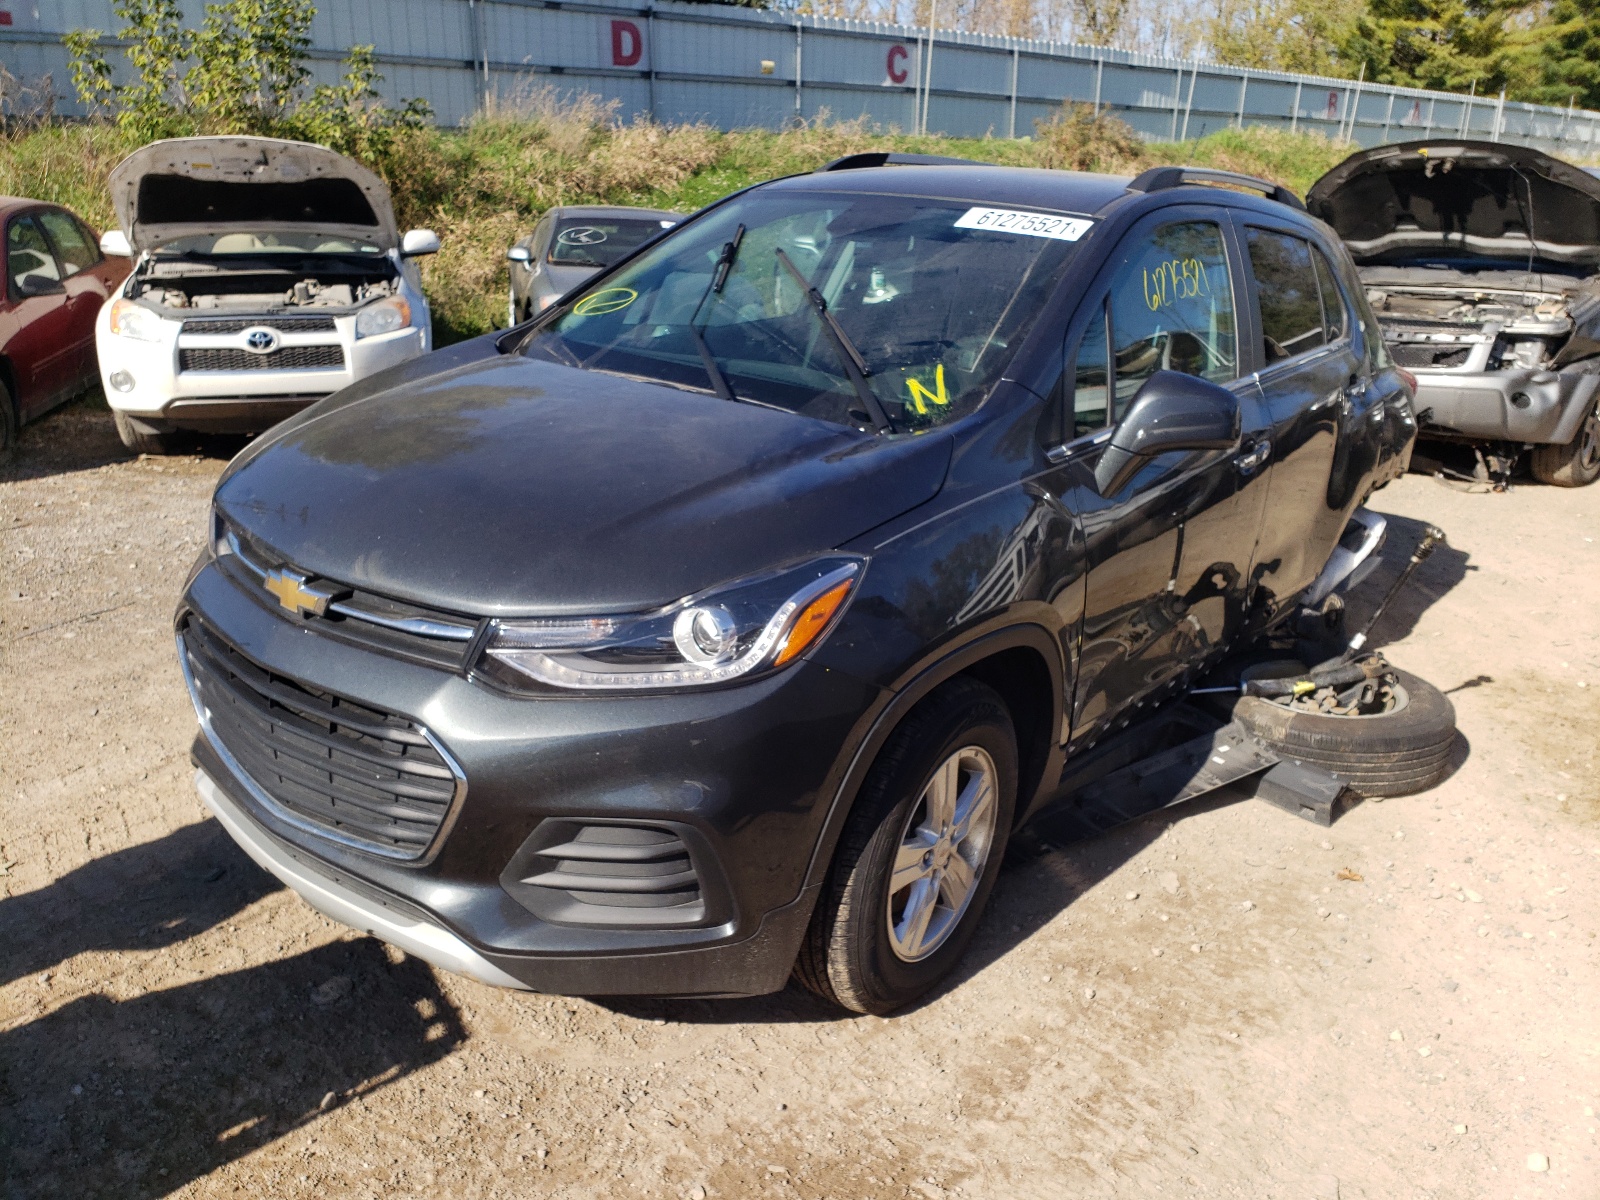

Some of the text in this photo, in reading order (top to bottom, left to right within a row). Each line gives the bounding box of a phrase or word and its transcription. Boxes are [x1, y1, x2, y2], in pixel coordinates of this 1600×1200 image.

[611, 20, 642, 67] D
[886, 44, 909, 84] C
[976, 211, 1073, 235] 61275521
[905, 363, 949, 414] N
